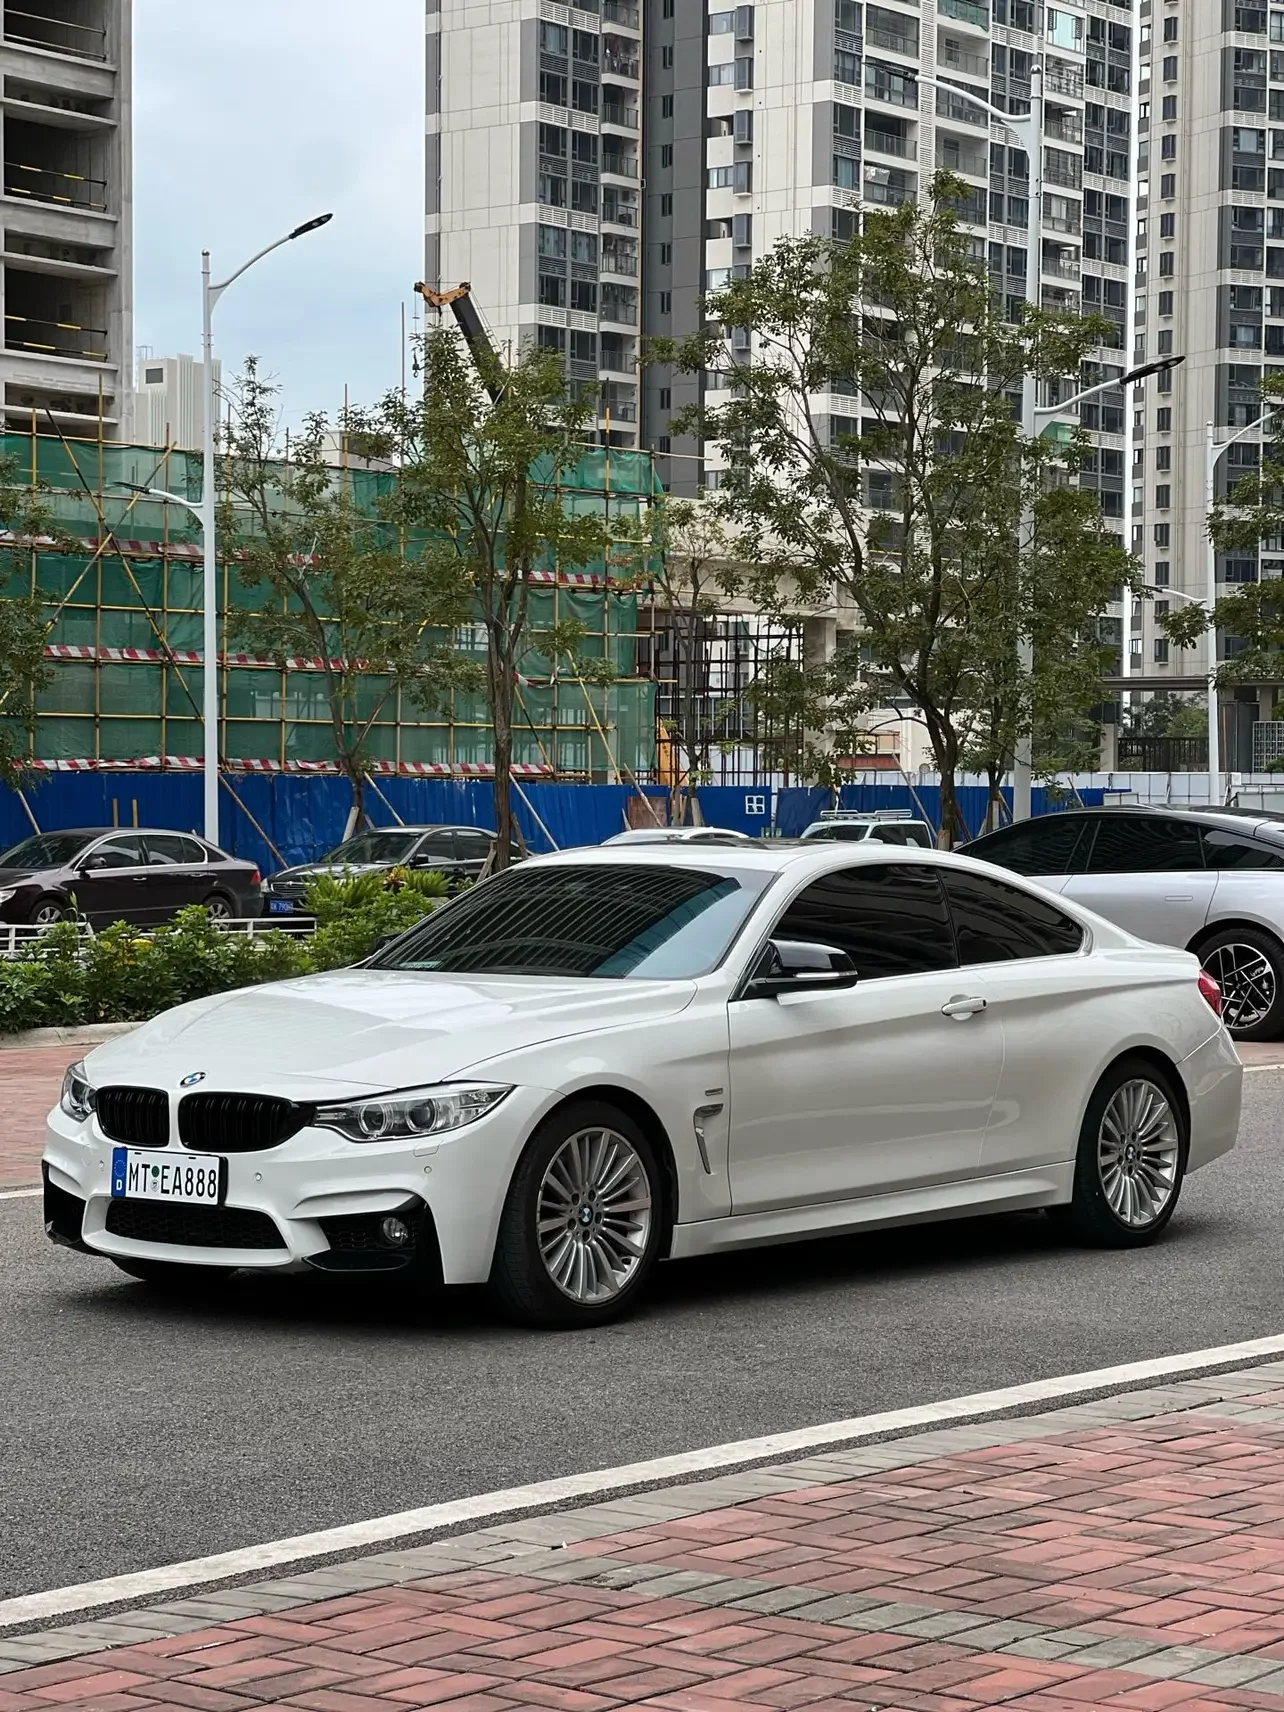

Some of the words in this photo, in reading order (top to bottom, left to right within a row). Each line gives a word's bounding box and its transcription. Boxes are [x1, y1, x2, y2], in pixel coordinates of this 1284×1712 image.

[116, 1179, 123, 1191] D
[128, 1162, 150, 1192] MT
[160, 1165, 217, 1198] EA888
